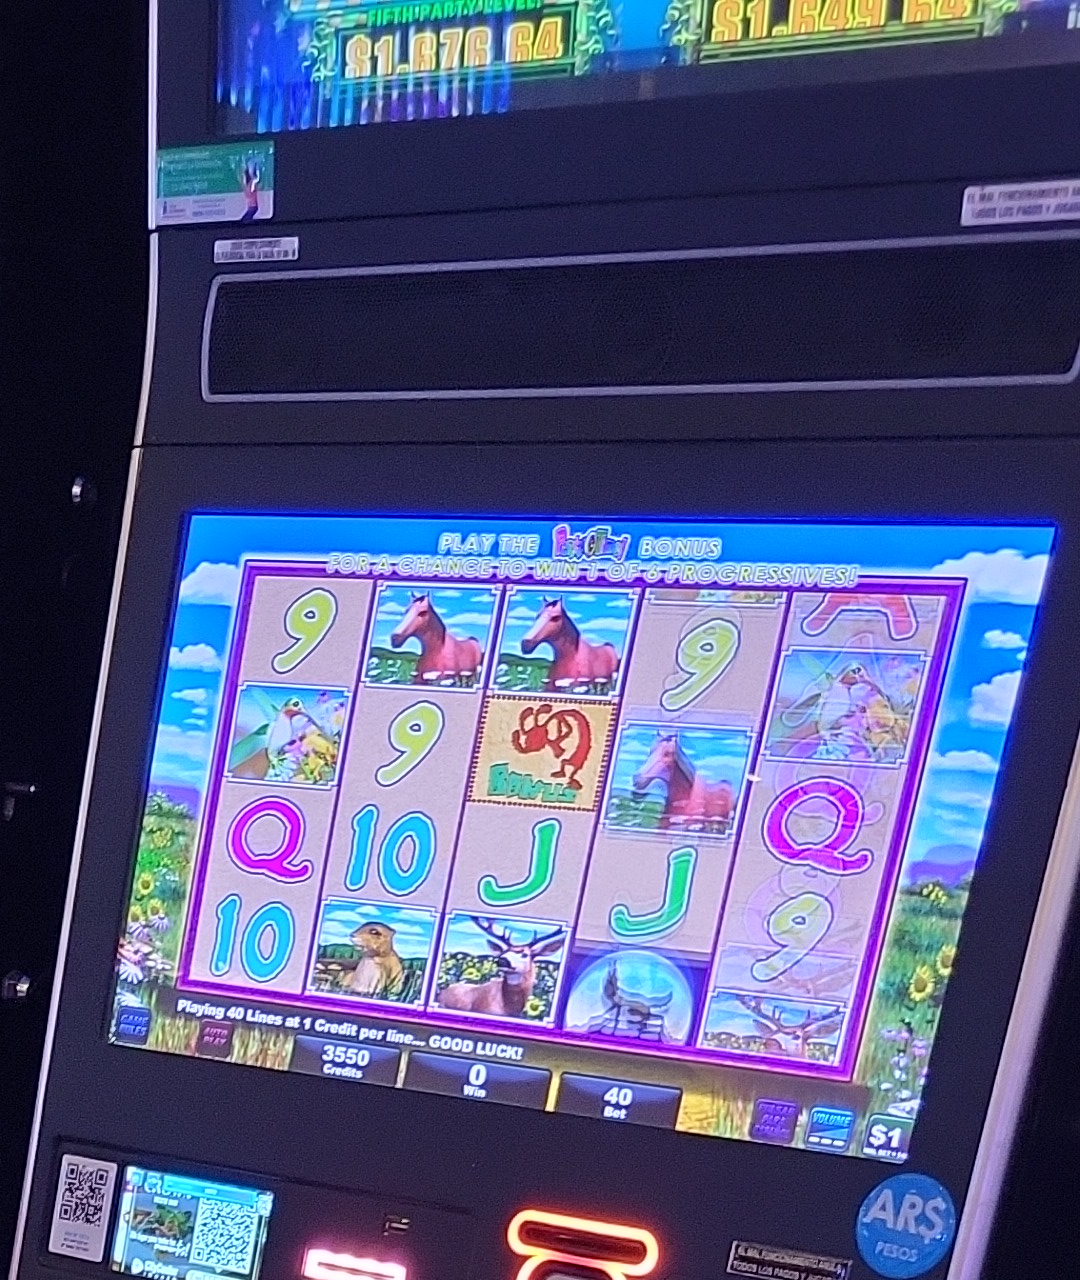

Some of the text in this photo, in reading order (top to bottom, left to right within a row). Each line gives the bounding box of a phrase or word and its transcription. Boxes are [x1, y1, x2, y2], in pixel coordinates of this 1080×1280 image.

[326, 552, 373, 575] FOR
[376, 555, 393, 575] A
[397, 556, 494, 578] CHANCE
[496, 559, 527, 579] TO
[534, 559, 578, 580] WIN
[607, 562, 642, 582] OF
[647, 564, 660, 582] 6
[664, 565, 859, 588] PROGRESSIVES!
[440, 534, 722, 559] PLAY THE BONUS
[272, 587, 340, 676] 9
[660, 617, 742, 713] 9
[374, 699, 446, 788] 9
[226, 795, 315, 884] Q
[346, 804, 438, 898] 10
[762, 776, 875, 877] Q
[477, 818, 562, 909] J
[609, 845, 698, 942] J
[209, 893, 294, 984] 10
[749, 893, 834, 984] 9
[176, 1000, 226, 1022] Playing
[227, 1006, 246, 1021] 40
[246, 1009, 283, 1028] Lines
[285, 1015, 301, 1030] at
[314, 1018, 358, 1039] Credit
[359, 1026, 385, 1044] per
[429, 1034, 473, 1054] GOOD
[475, 1039, 525, 1062] LUCK!
[322, 1044, 371, 1068] 3550
[323, 1063, 363, 1080] Credits
[468, 1063, 488, 1087] 0
[463, 1085, 487, 1099] Win
[603, 1088, 633, 1107] 40
[603, 1106, 628, 1121] Bet
[811, 1111, 851, 1128] VOLUME
[869, 1123, 903, 1150] $1
[875, 1240, 919, 1263] PESOS
